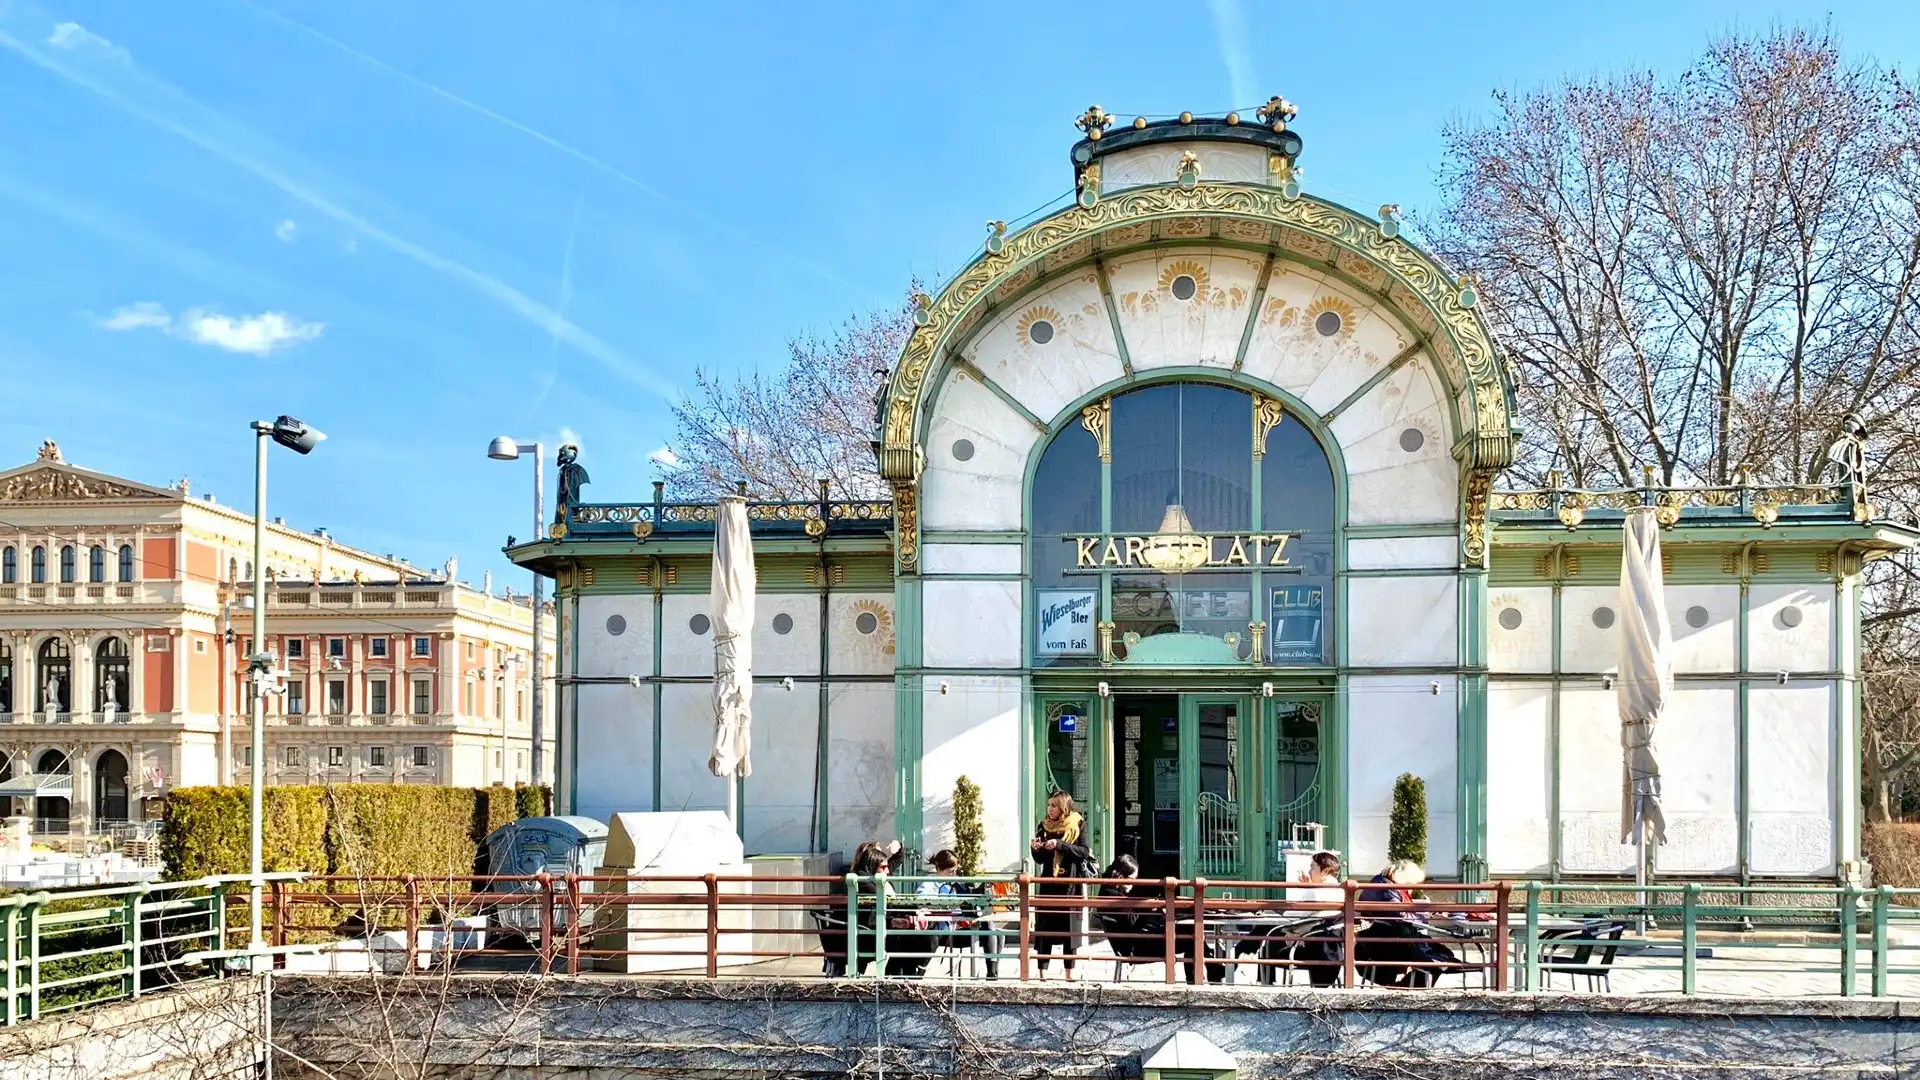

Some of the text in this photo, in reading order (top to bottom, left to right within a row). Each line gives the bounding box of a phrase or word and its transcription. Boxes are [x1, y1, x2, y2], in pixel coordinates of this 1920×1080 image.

[1076, 534, 1290, 567] KARPLATZ
[1132, 591, 1228, 617] CAFE
[1273, 590, 1321, 607] CLUB
[1042, 595, 1092, 635] Wieselburger
[1071, 611, 1088, 623] Bier
[1046, 638, 1087, 649] vom Faß
